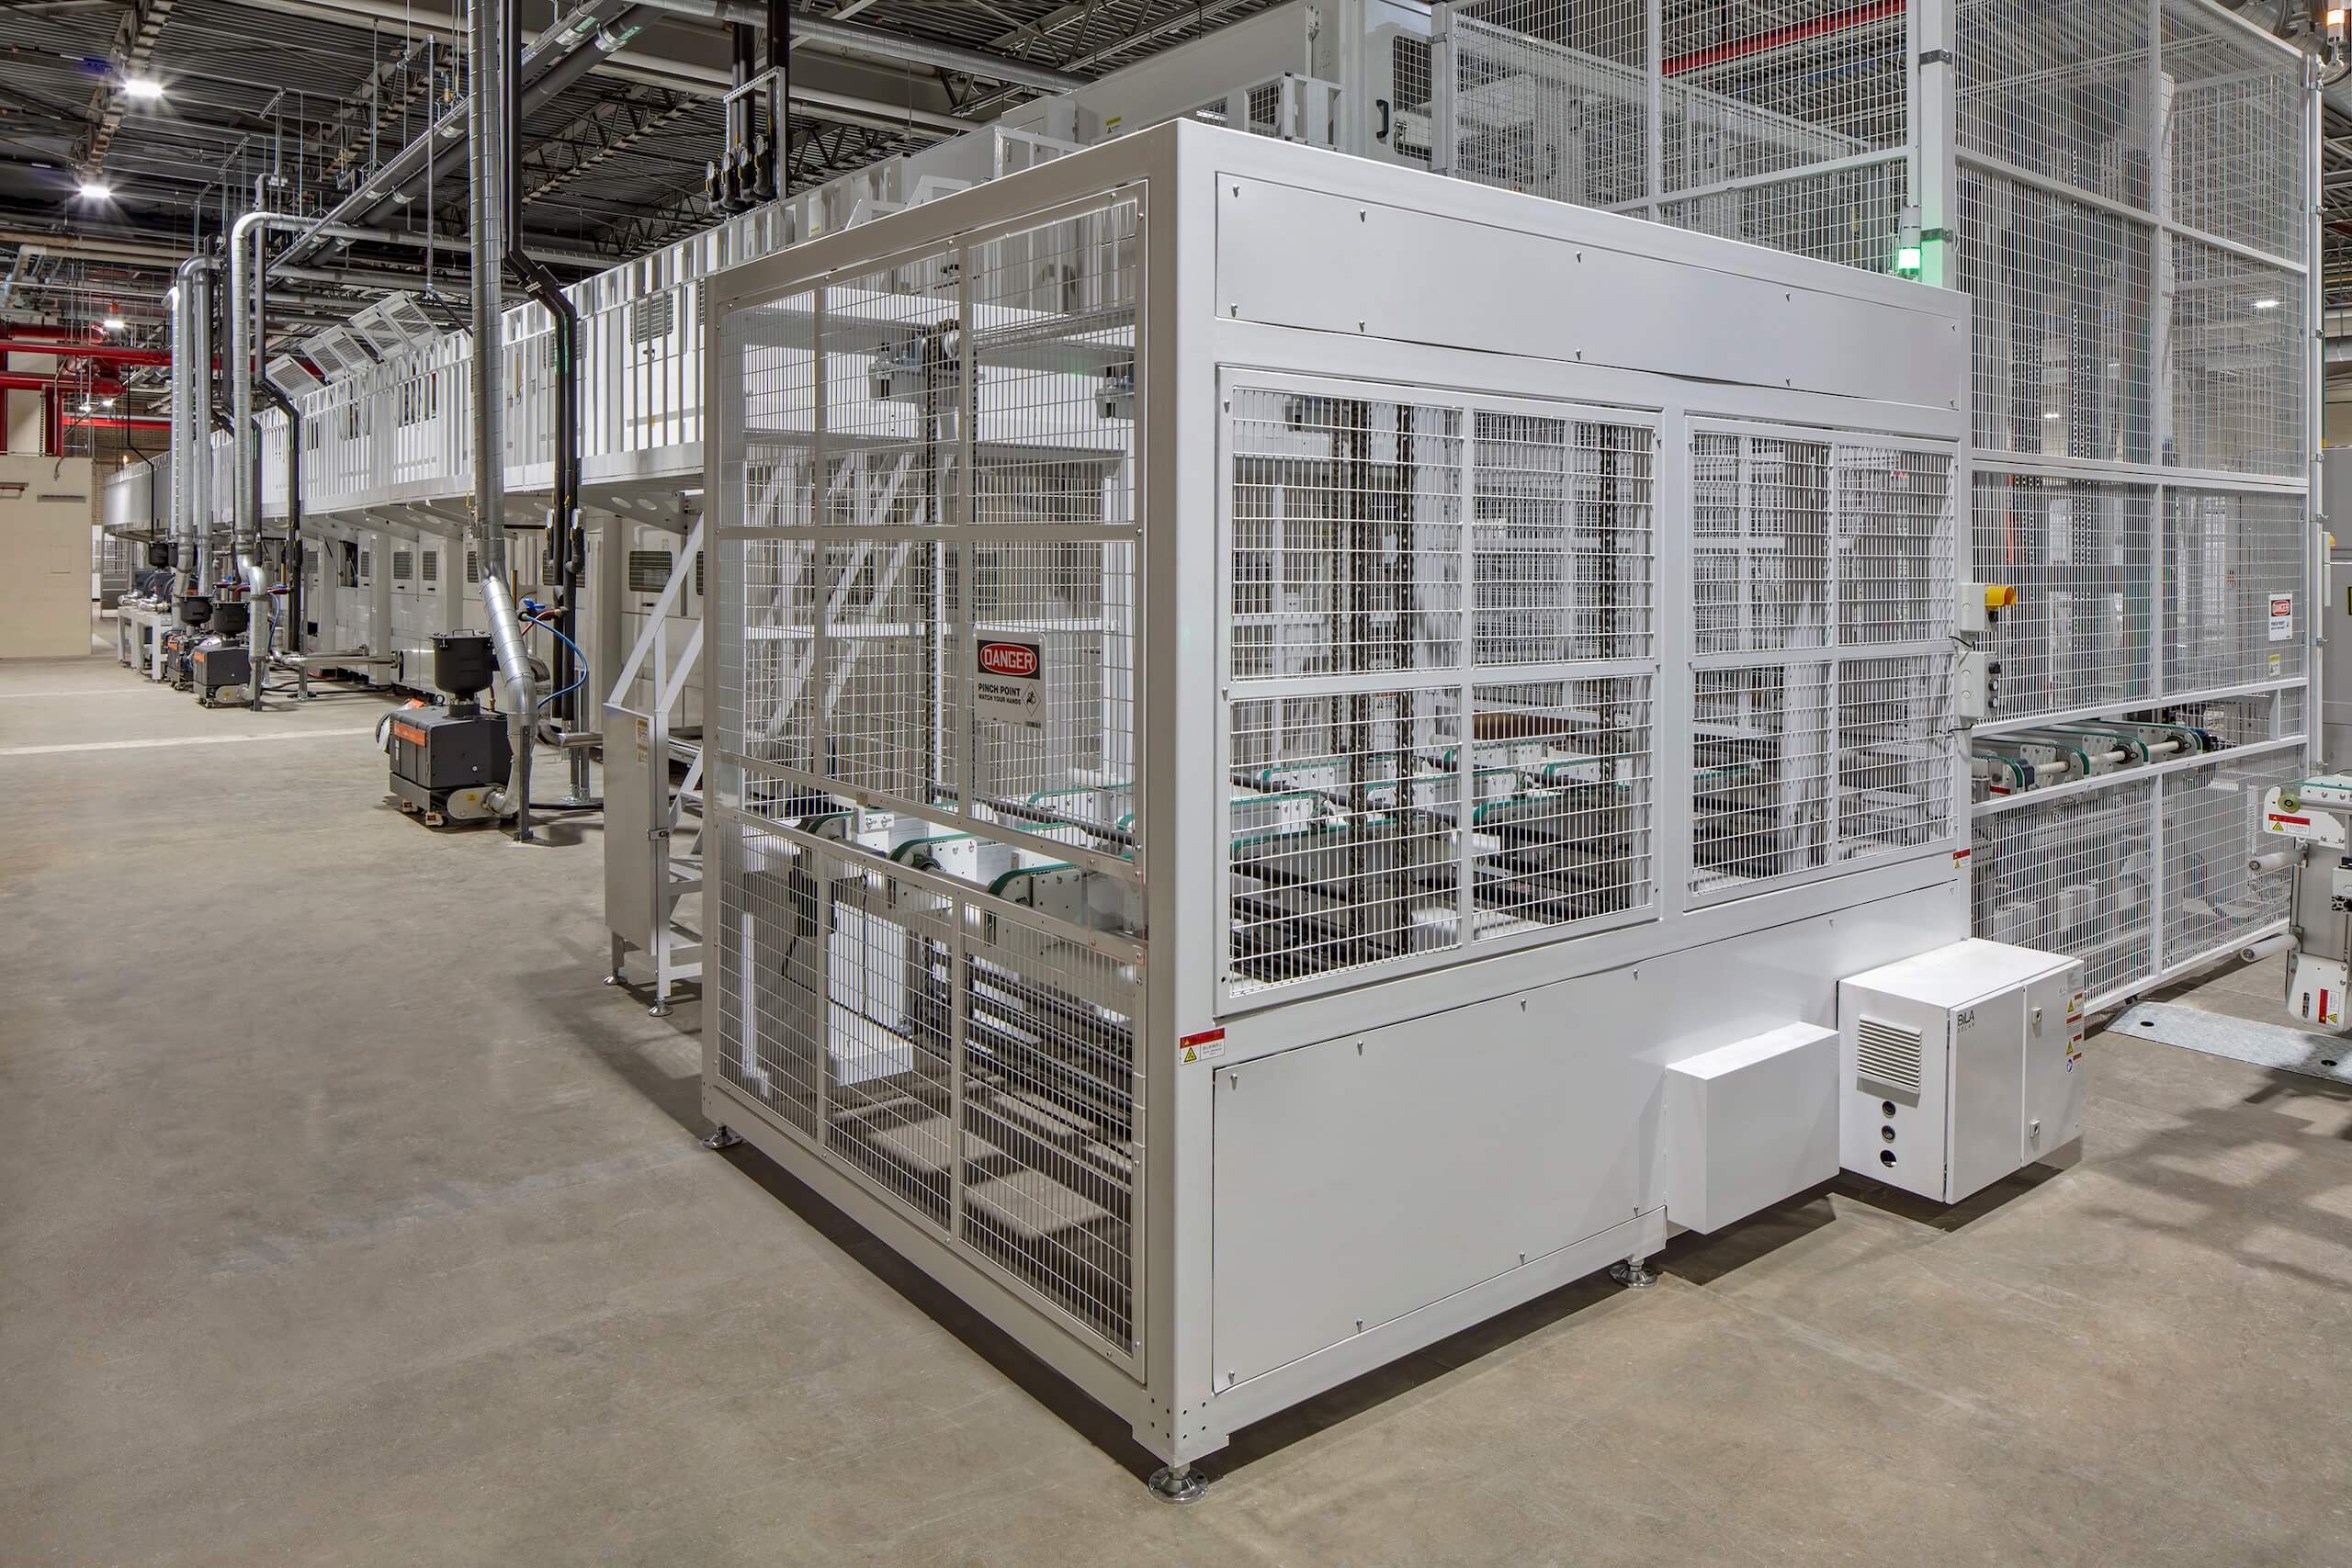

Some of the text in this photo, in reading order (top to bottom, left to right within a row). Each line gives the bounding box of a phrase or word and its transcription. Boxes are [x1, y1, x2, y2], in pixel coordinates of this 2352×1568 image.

[984, 649, 1033, 670] DANGER
[978, 682, 1021, 697] PINCH POINT
